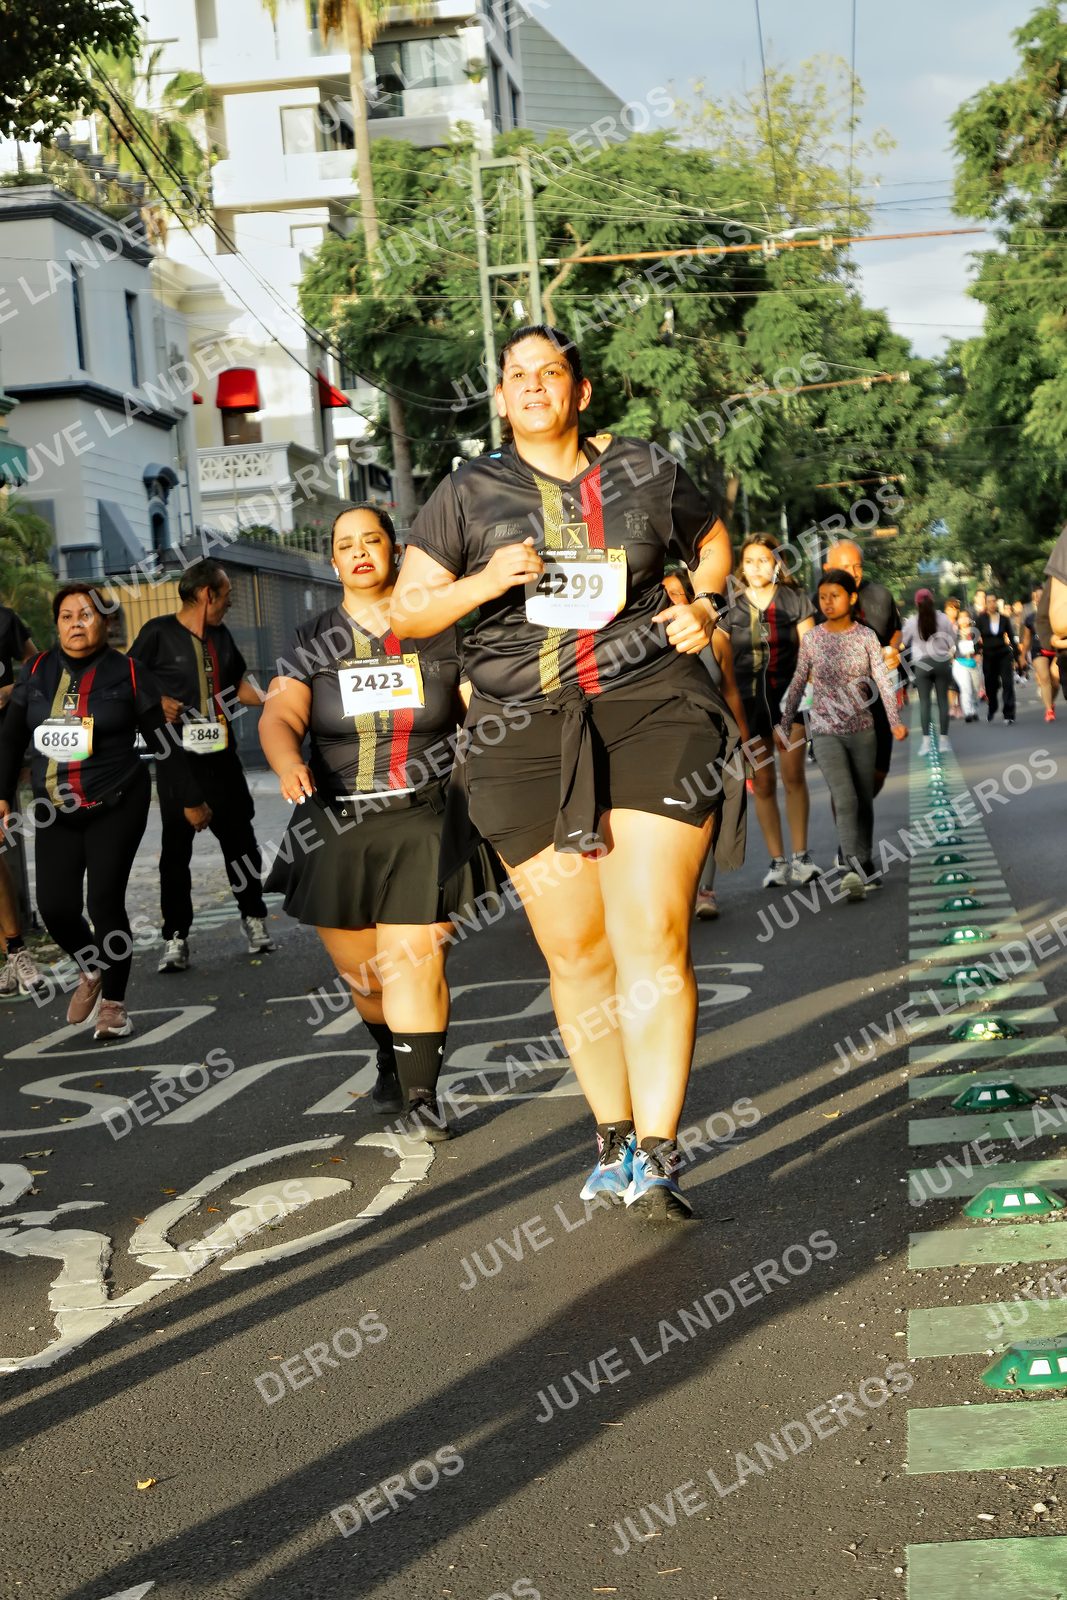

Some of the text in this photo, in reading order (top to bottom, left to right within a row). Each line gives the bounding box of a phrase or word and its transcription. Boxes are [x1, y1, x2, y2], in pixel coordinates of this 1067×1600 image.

[536, 573, 604, 599] 4299
[351, 672, 403, 692] 2423
[41, 732, 79, 746] 6865
[190, 728, 219, 741] 5848
